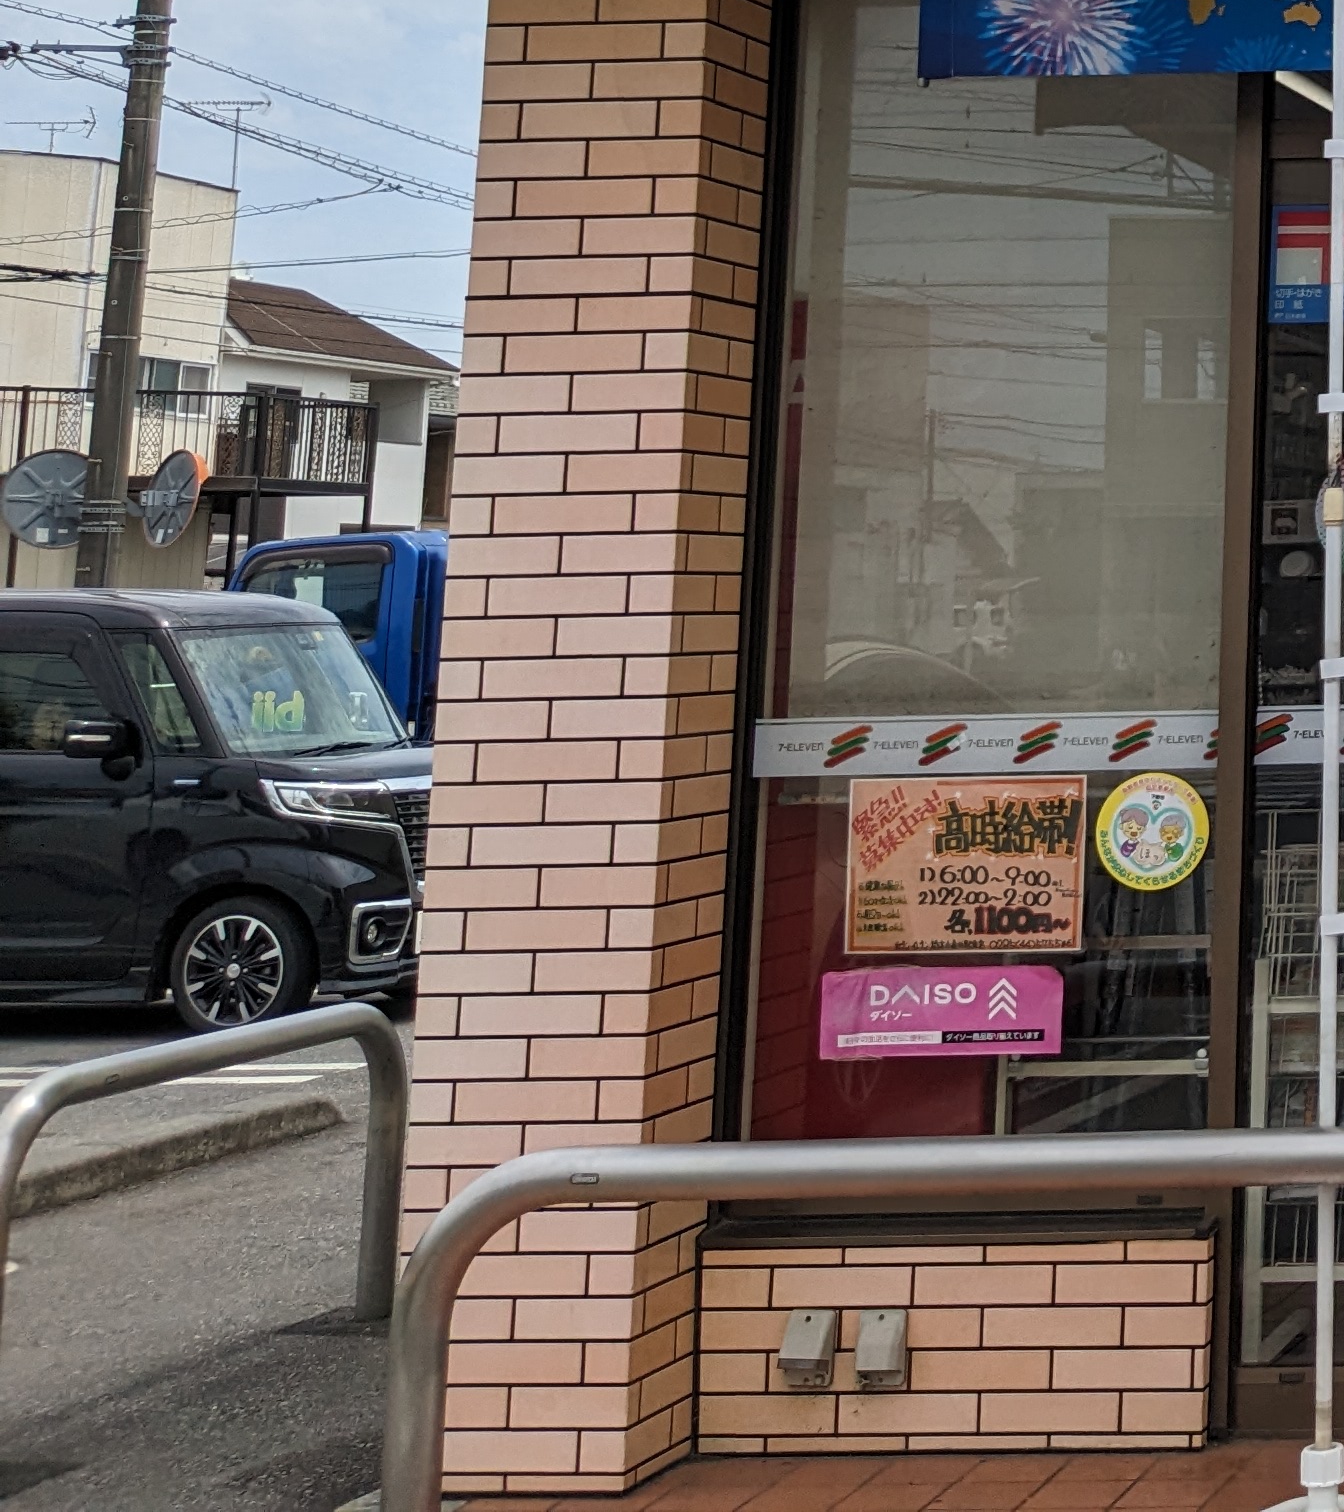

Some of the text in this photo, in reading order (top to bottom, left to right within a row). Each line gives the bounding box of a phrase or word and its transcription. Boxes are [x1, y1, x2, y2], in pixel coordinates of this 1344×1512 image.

[869, 982, 978, 1007] DAISO
[869, 1009, 913, 1022] ダイソー
